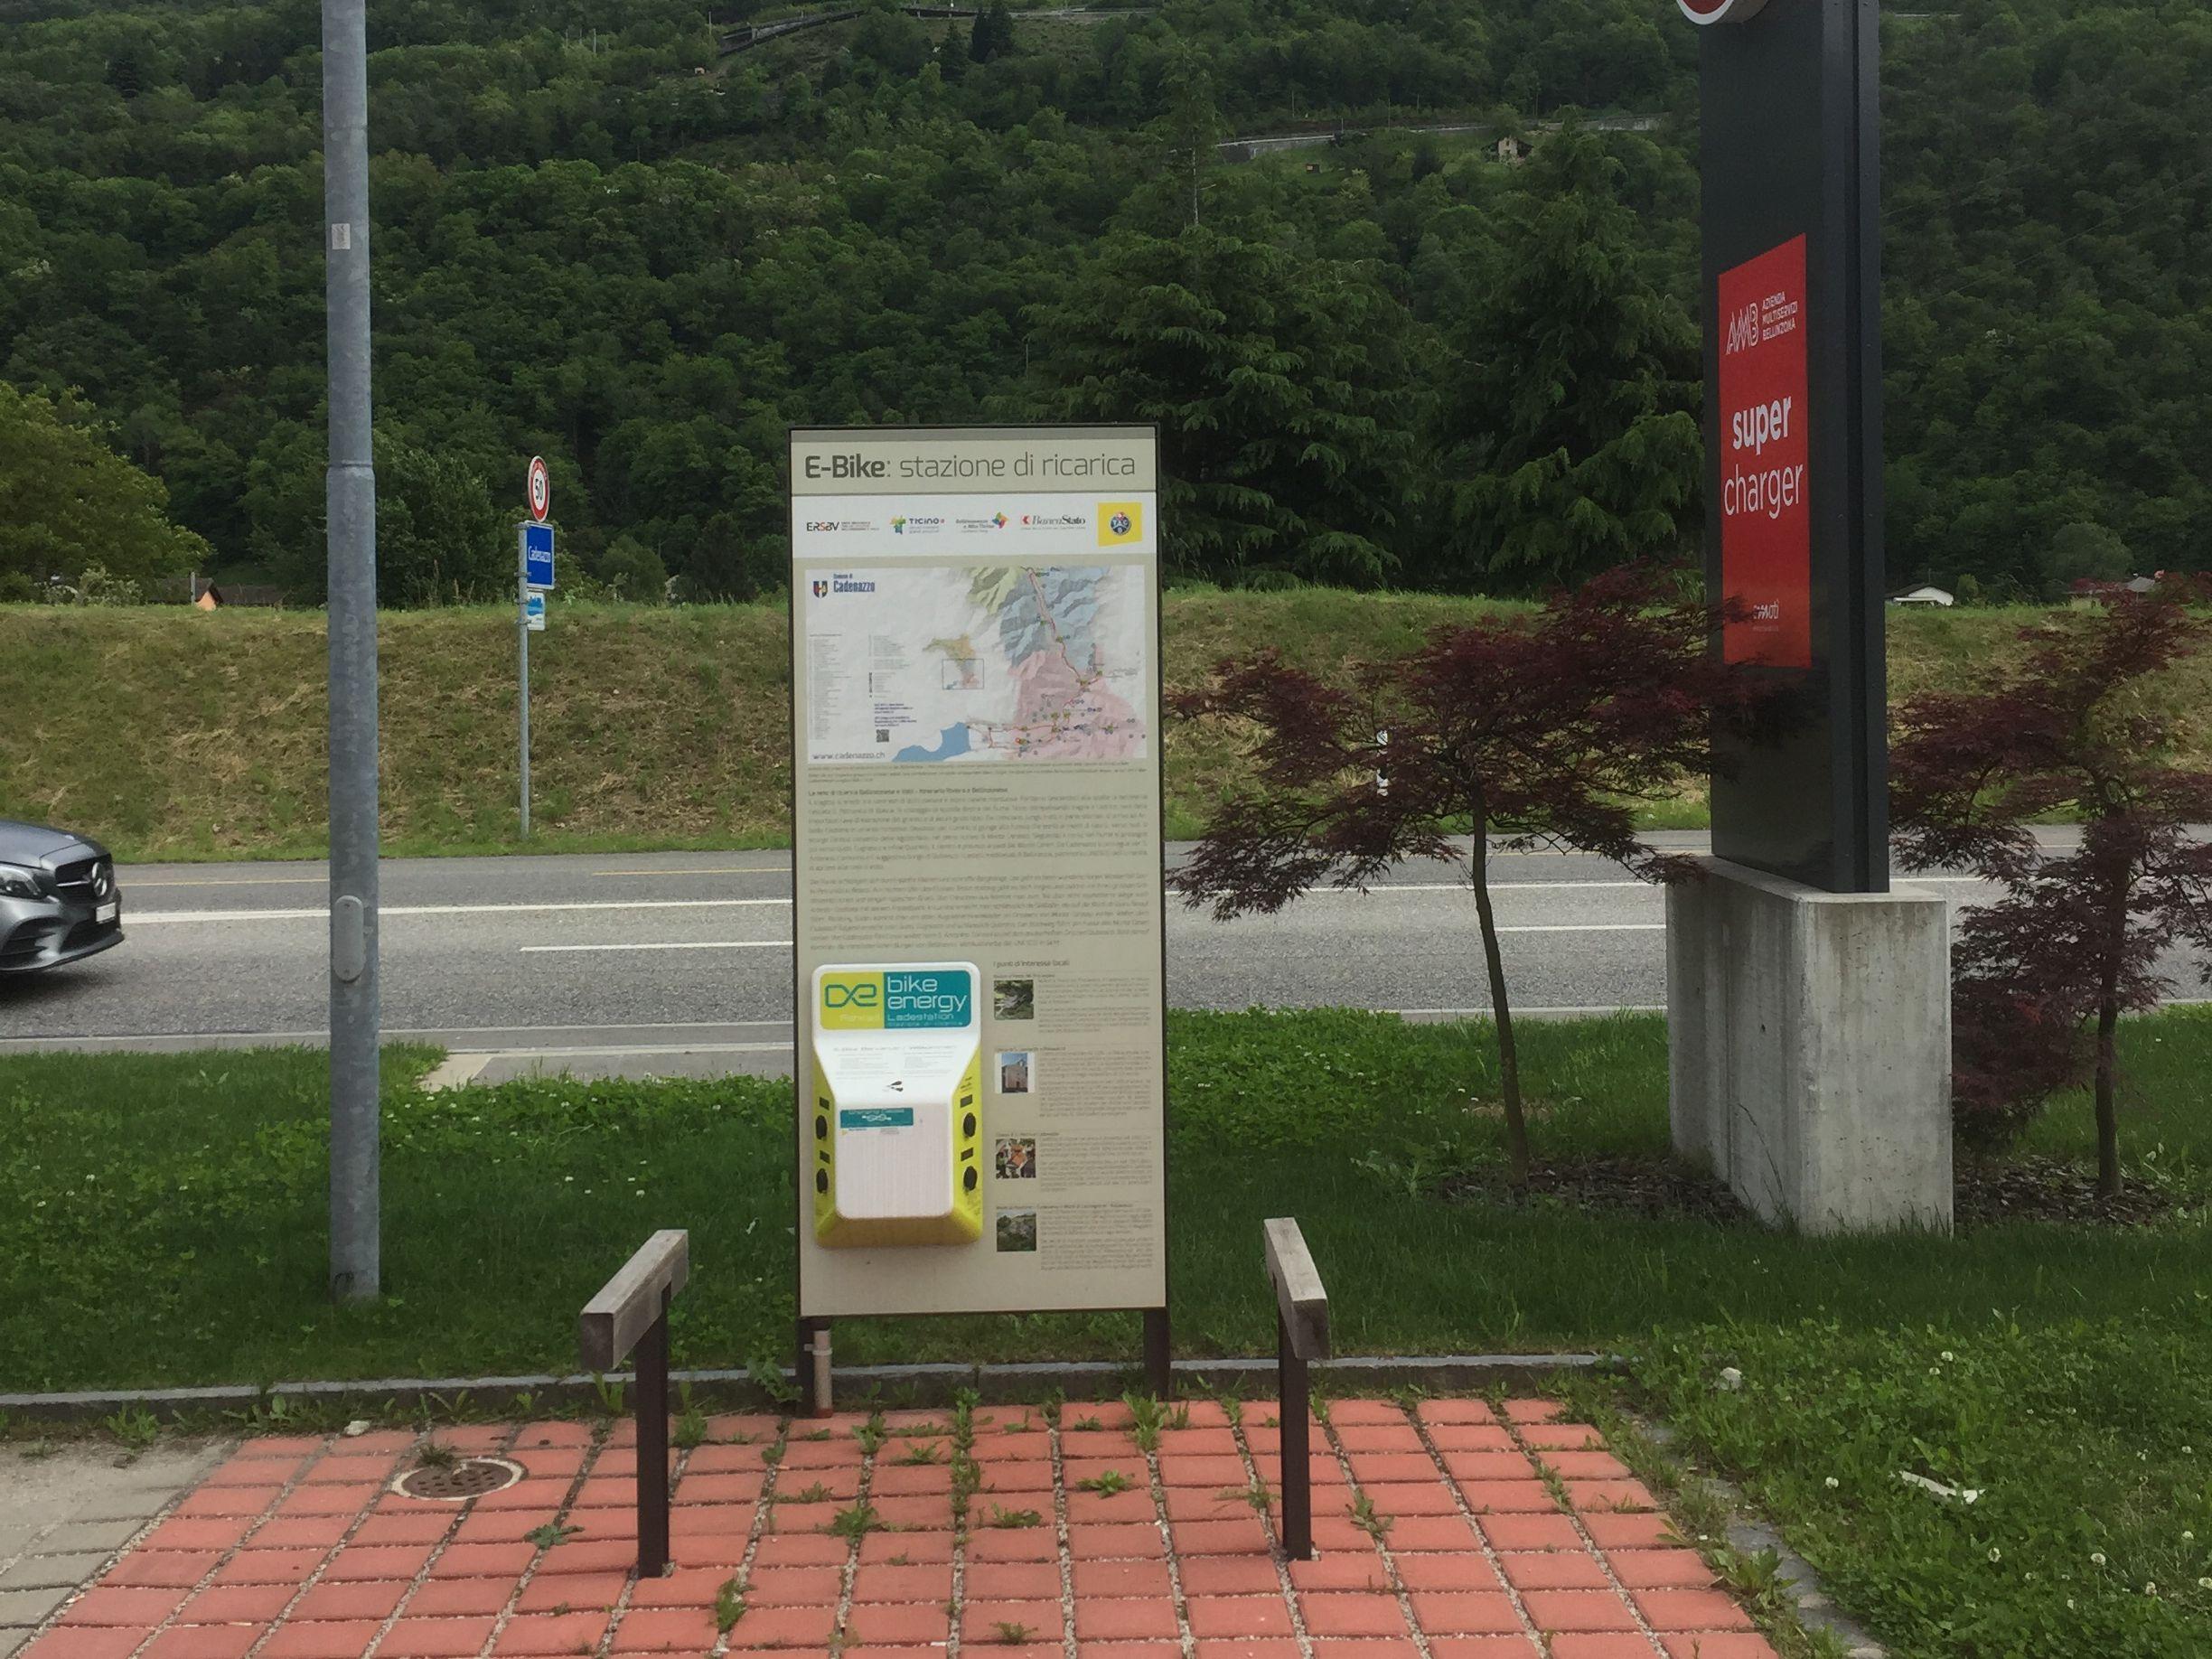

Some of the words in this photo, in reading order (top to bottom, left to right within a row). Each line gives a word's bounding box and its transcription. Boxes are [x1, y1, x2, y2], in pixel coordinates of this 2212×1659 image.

[1732, 396, 1792, 455] super
[805, 454, 891, 479] E-Bike:
[900, 455, 1006, 478] stazione
[1014, 452, 1034, 477] di
[1043, 454, 1136, 476] ricarica
[1724, 464, 1804, 520] charger
[833, 580, 876, 593] Cadenazzo
[812, 751, 886, 760] www.cadenazzo.ch
[887, 975, 938, 993] bike
[887, 995, 967, 1013] energy
